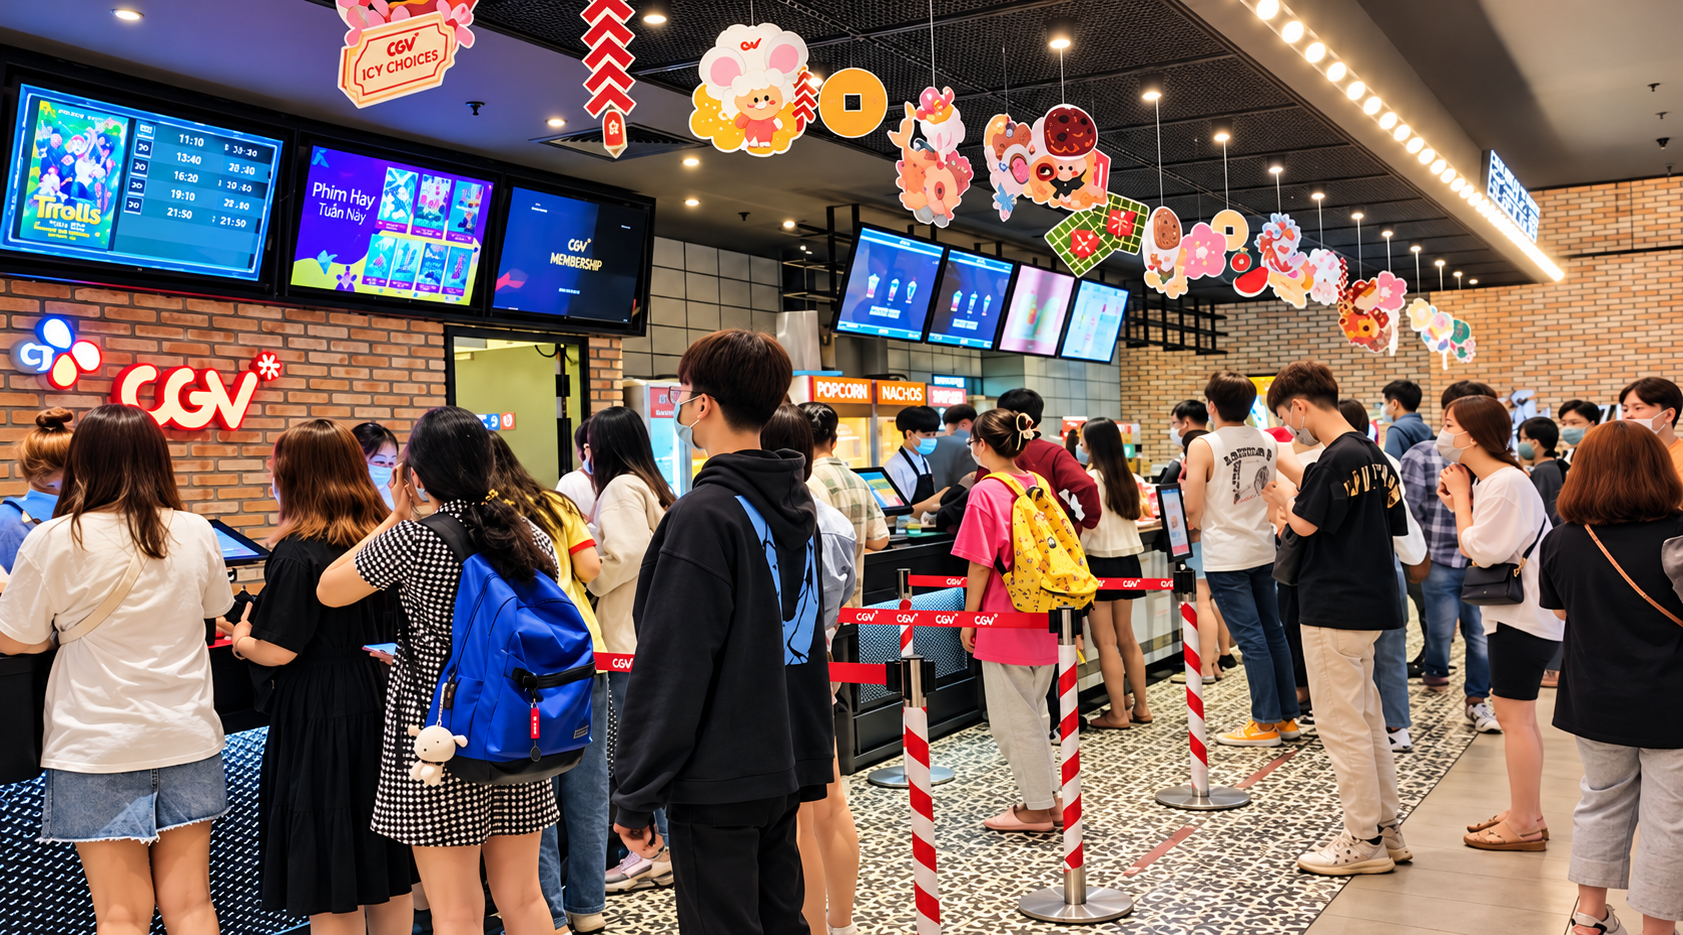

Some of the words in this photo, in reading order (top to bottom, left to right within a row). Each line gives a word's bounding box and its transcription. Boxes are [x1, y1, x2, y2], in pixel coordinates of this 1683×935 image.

[387, 33, 418, 57] CGV
[362, 64, 383, 81] ICY
[386, 49, 438, 74] CHOICES
[179, 134, 204, 147] 11:10
[176, 152, 201, 165] 13:40
[174, 171, 198, 183] 16:20
[171, 189, 195, 201] 19:10
[312, 181, 347, 203] Phim
[350, 188, 376, 210] Hay
[167, 207, 192, 219] 21:50
[220, 217, 246, 228] 21:50
[568, 238, 590, 253] CGV
[549, 252, 602, 272] MEMBERSHIP
[112, 363, 258, 430] CGV
[816, 381, 868, 399] POPCORN
[882, 385, 922, 401] NACHOS
[856, 610, 878, 622] CGV
[897, 613, 918, 623] CGV
[935, 613, 958, 624] CGV
[974, 613, 998, 625] CGV
[612, 657, 634, 669] CGV
